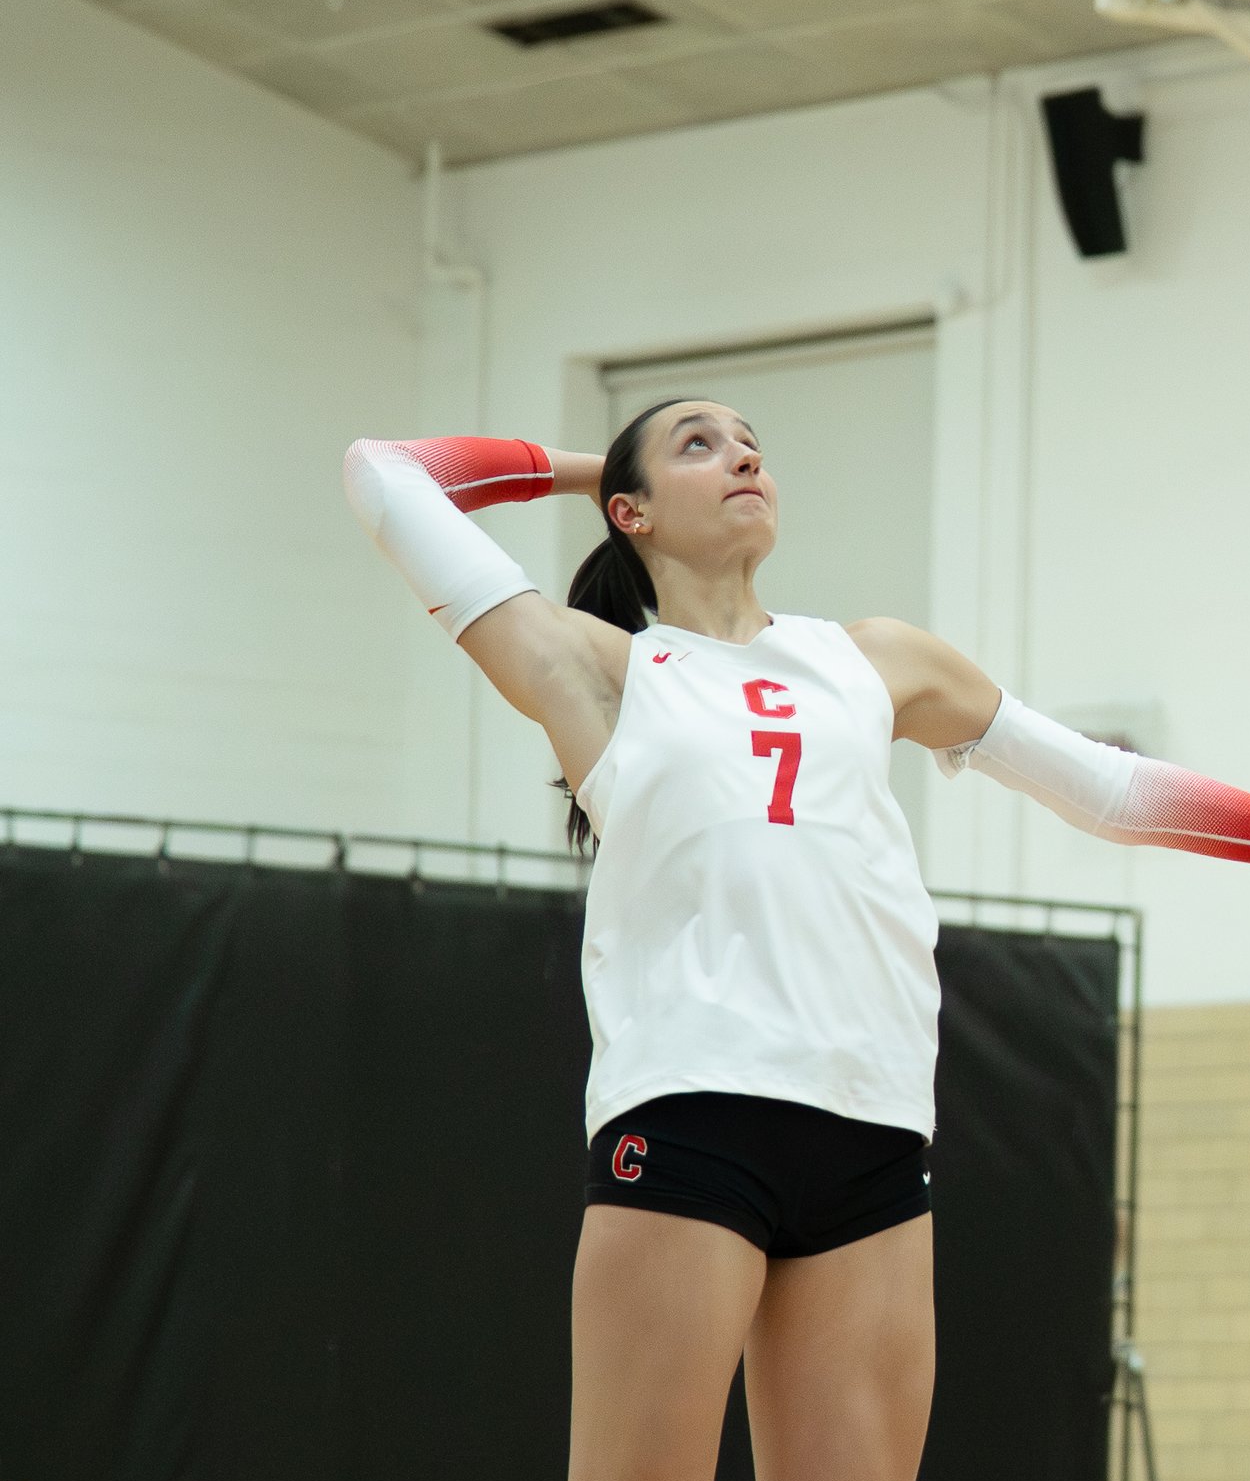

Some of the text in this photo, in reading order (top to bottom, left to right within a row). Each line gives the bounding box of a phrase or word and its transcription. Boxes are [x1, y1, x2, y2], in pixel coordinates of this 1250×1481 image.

[742, 679, 796, 719] C
[751, 730, 802, 826] 7
[612, 1134, 647, 1182] C
